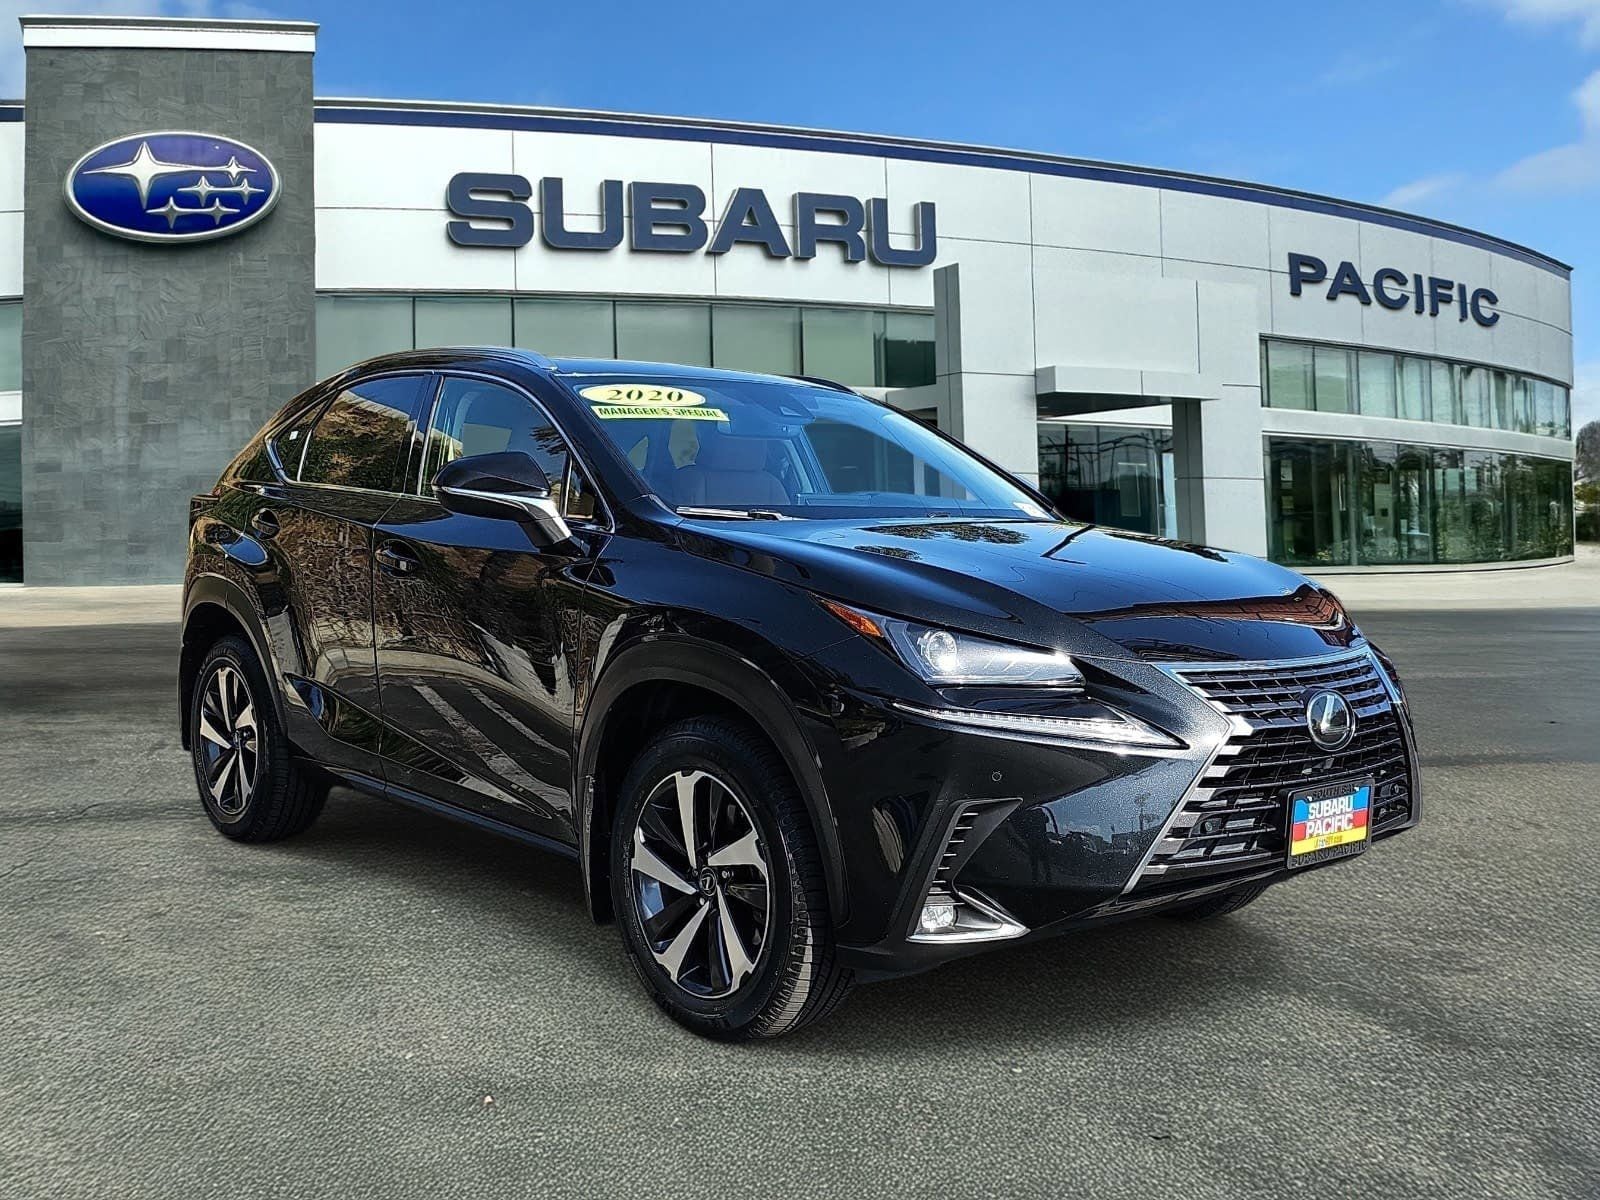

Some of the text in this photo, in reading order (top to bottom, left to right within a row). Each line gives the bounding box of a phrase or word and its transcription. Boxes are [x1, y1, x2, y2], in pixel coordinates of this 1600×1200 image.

[447, 171, 937, 267] SUBARU
[1288, 252, 1500, 327] PACIFIC
[606, 389, 684, 402] 2020
[598, 407, 721, 418] MANAGER'S SPECIAL
[1313, 786, 1339, 799] SOUTH
[1308, 795, 1354, 819] SUBARU
[1305, 813, 1354, 839] PACIFIC
[1291, 848, 1331, 866] SUBARU
[1331, 840, 1367, 858] PACIFIC
